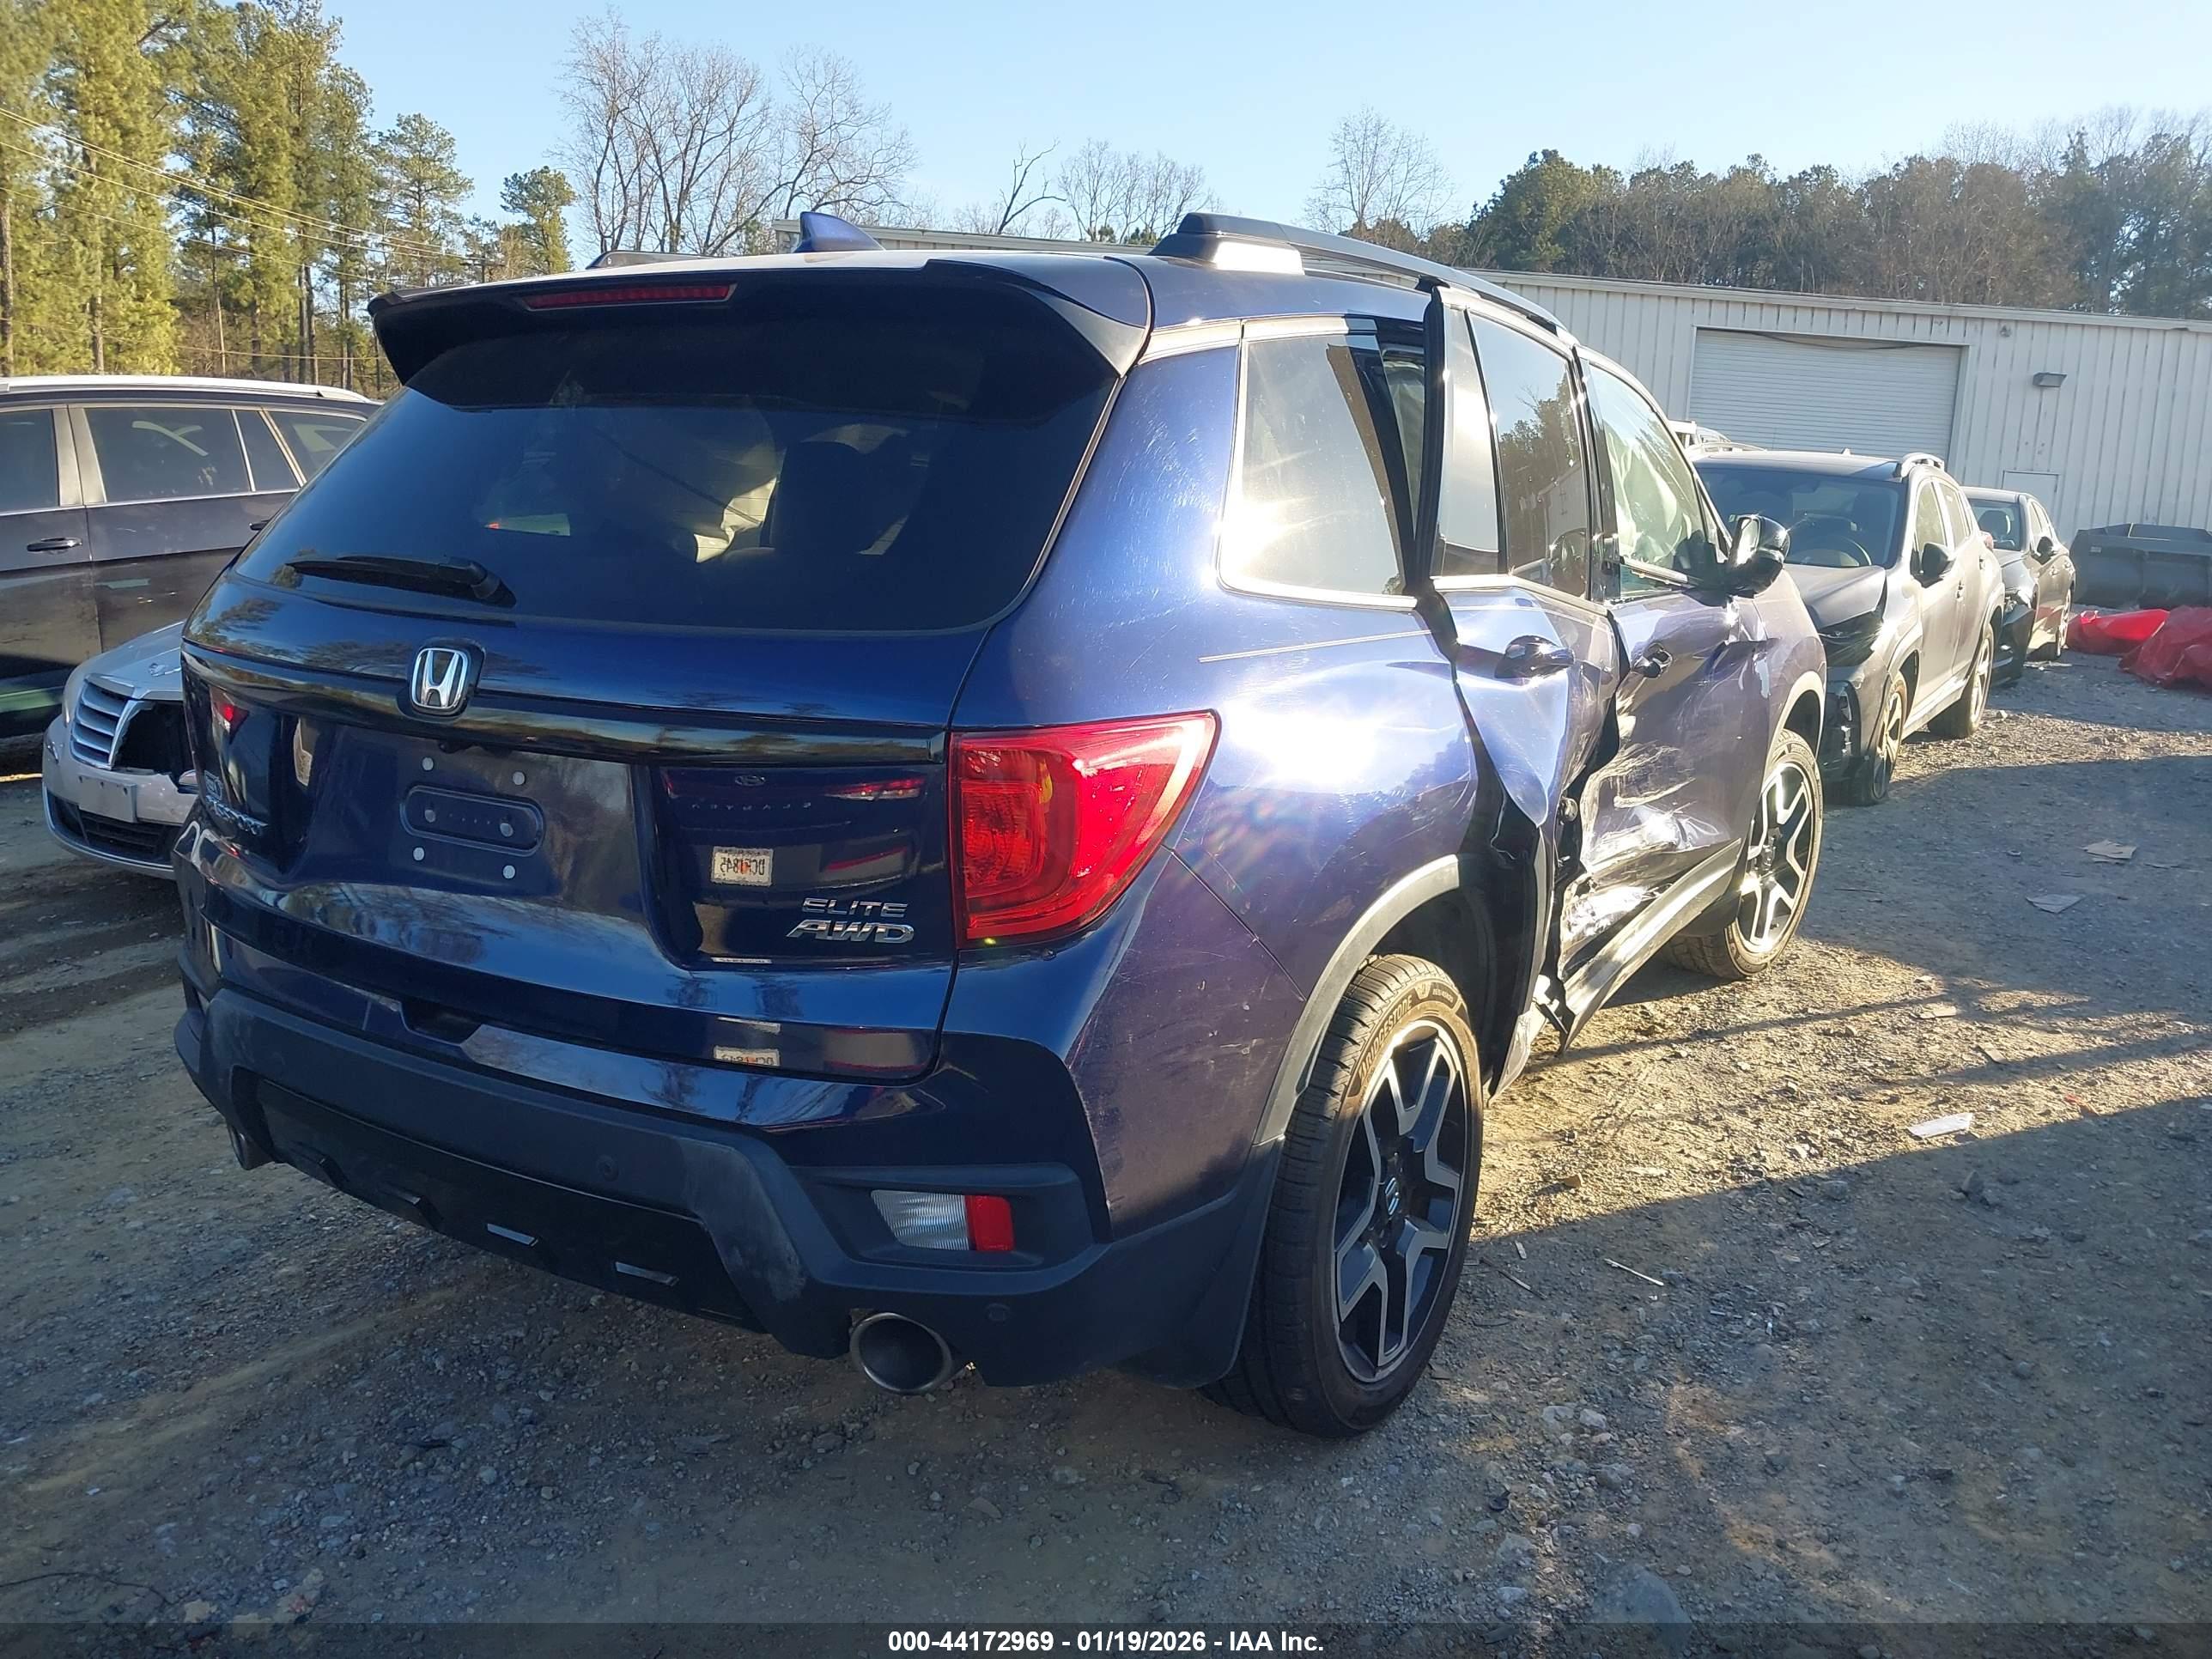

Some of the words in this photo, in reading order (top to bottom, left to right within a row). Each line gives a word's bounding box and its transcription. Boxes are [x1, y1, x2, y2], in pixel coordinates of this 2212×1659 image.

[801, 897, 908, 918] ELITE
[786, 919, 915, 943] AWD
[1358, 994, 1413, 1082] BRIDGESTONE
